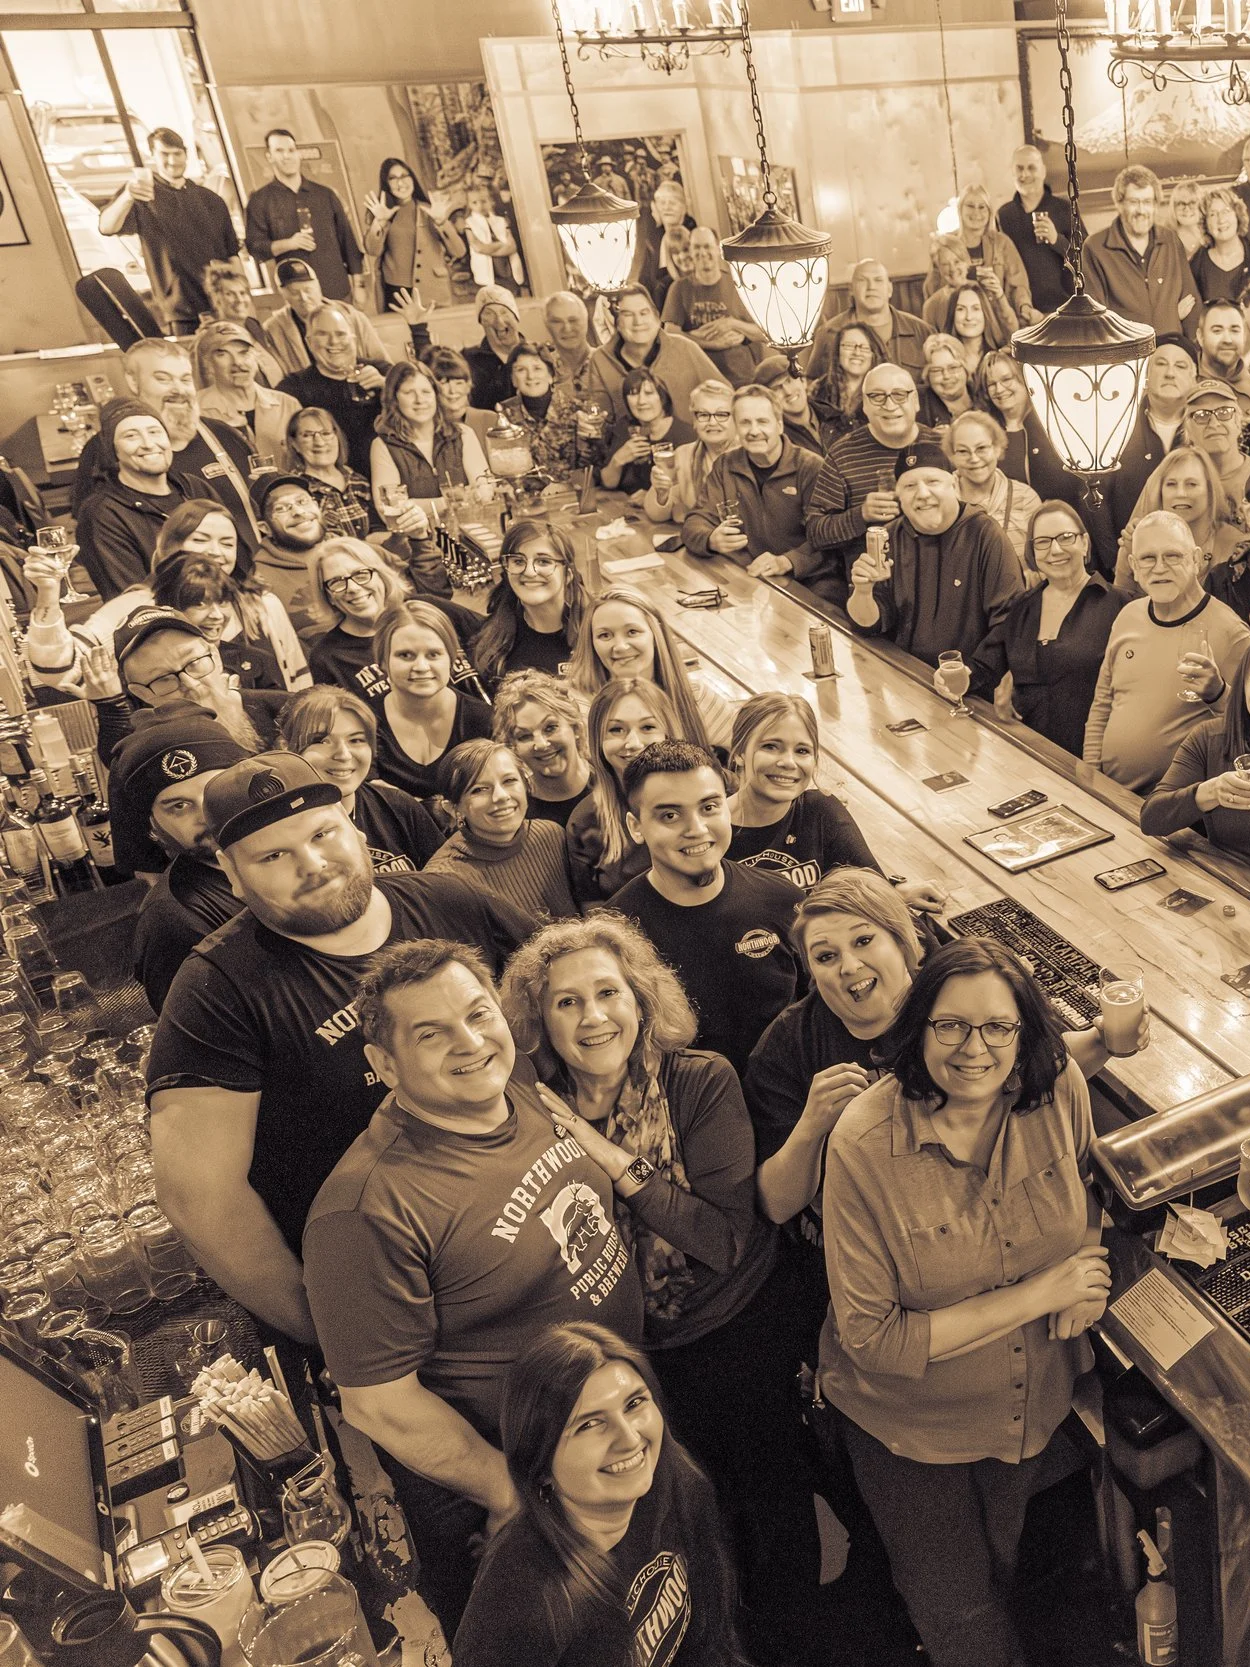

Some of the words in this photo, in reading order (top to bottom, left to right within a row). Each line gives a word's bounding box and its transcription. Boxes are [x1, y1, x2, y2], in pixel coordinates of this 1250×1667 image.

[737, 934, 778, 952] NORTHWOOD
[1050, 941, 1100, 979] CAMPAR
[569, 1257, 609, 1301] PUBLIC
